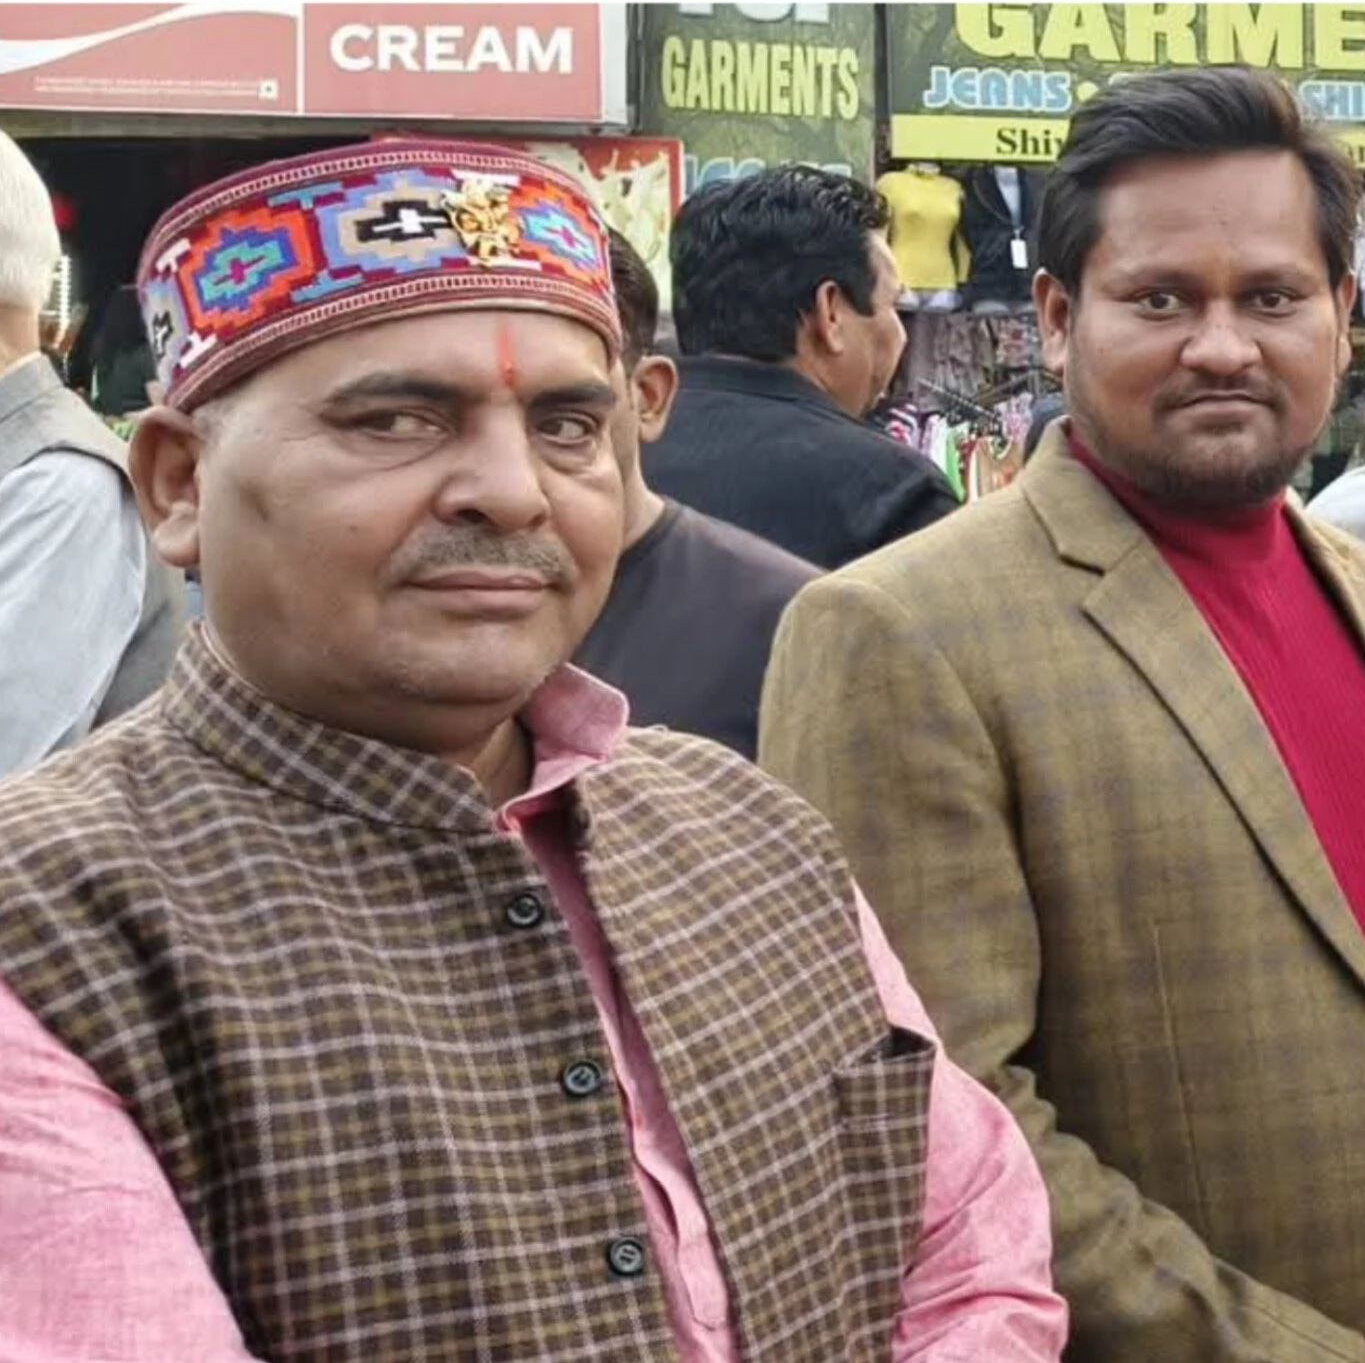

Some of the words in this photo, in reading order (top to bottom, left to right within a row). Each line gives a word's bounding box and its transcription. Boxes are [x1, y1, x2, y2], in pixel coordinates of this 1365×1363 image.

[330, 23, 574, 74] CREAM
[661, 36, 859, 120] GARMENTS
[923, 66, 1072, 112] JEANS
